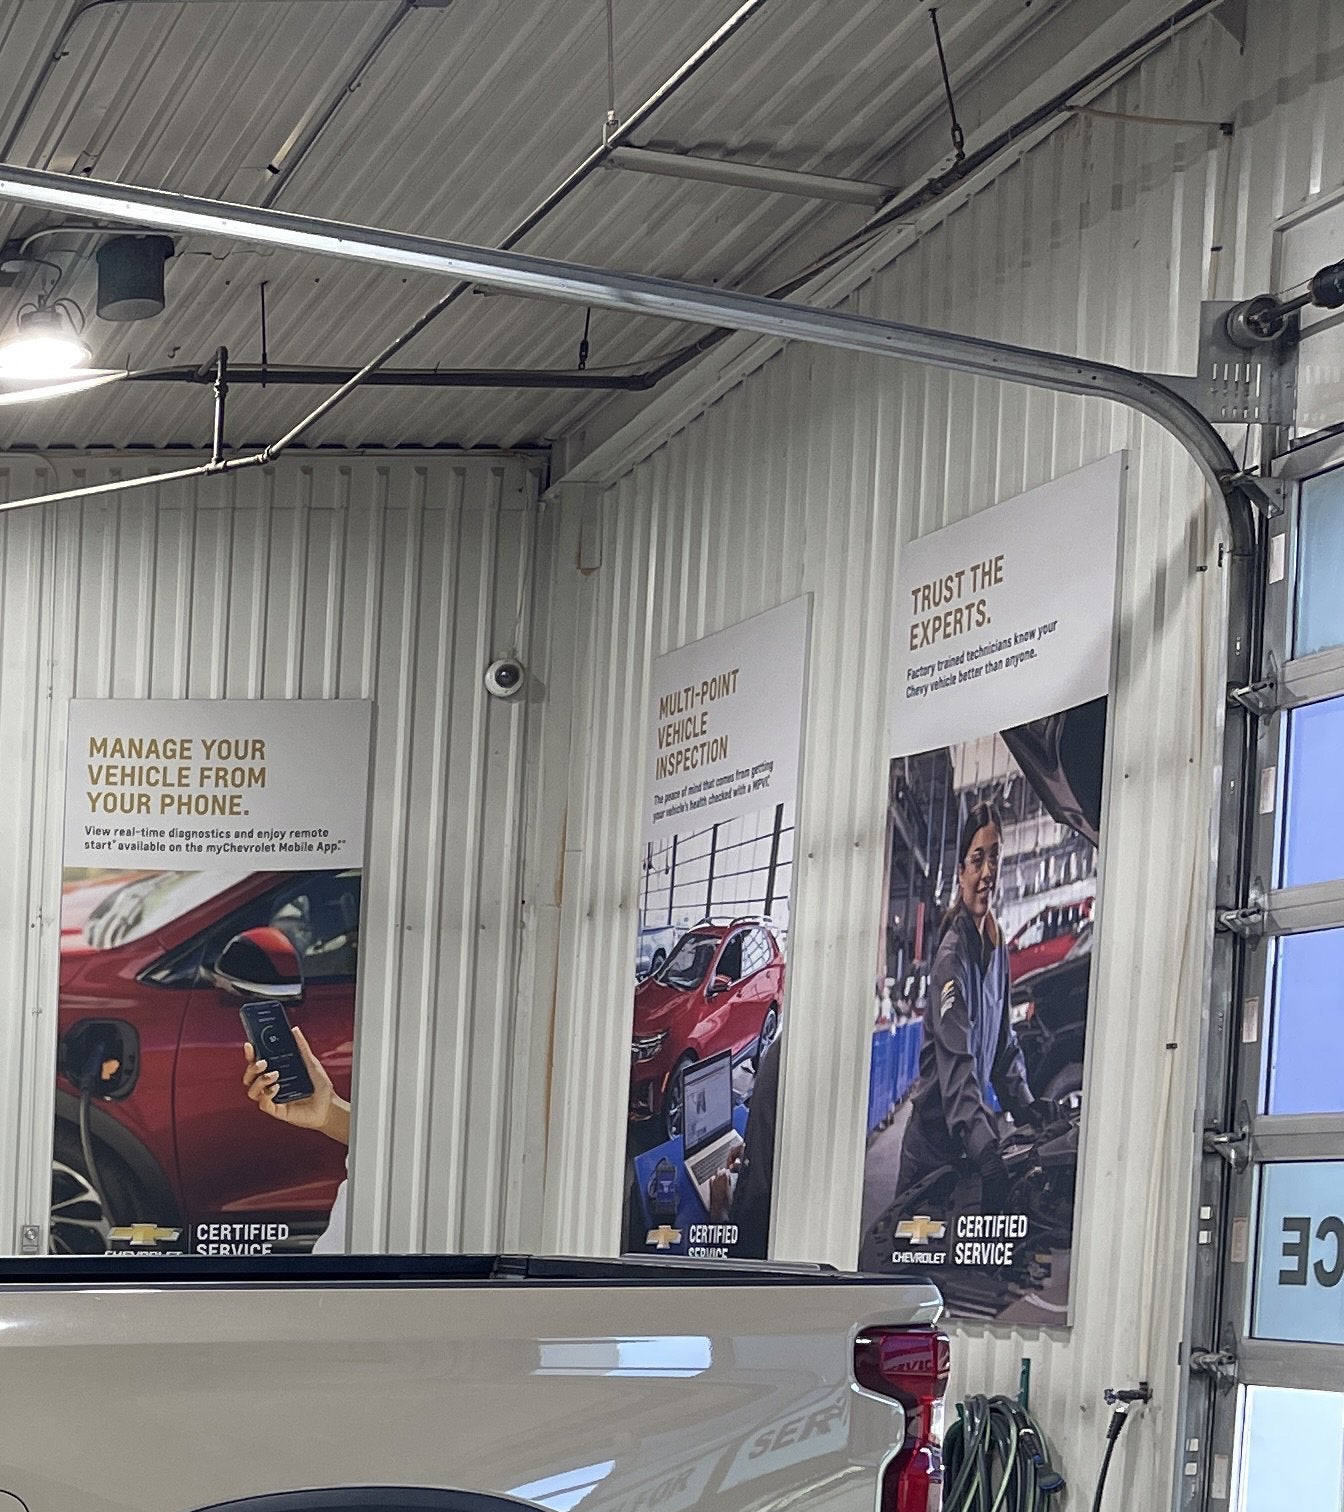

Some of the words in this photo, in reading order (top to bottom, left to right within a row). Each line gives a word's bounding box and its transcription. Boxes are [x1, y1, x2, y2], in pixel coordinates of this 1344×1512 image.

[912, 569, 965, 615] TRUST
[970, 554, 1004, 593] THE
[909, 599, 991, 651] EXPERTS.
[907, 663, 936, 681] Factory
[937, 651, 964, 671] trained
[966, 638, 1012, 661] technicians
[1014, 628, 1036, 646] know
[1038, 620, 1058, 640] your
[906, 682, 929, 698] Chevy
[930, 672, 956, 691] vehicle
[958, 665, 983, 684] better
[985, 659, 1003, 674] than
[1005, 648, 1037, 667] anyone.
[659, 668, 739, 720] MULTI-POINT
[658, 711, 708, 749] VEHICLE
[89, 737, 193, 760] MANAGE
[201, 739, 265, 760] YOUR
[656, 735, 728, 780] INSPECTION
[88, 765, 190, 787] VEHICLE
[200, 767, 266, 788] FROM
[87, 792, 151, 814] YOUR
[160, 794, 250, 815] PHONE.
[85, 826, 110, 836] View
[114, 827, 165, 838] real-time
[169, 828, 231, 840] diagnostics
[234, 829, 253, 838] and
[257, 829, 286, 840] enjoy
[289, 829, 328, 837] remote
[118, 841, 166, 851] available
[169, 843, 182, 851] on
[185, 842, 202, 852] the
[206, 842, 276, 854] myChevrolet
[279, 842, 313, 852] Mobile
[196, 1224, 289, 1240] CERTIFIED
[689, 1225, 738, 1243] CERTIFIED
[957, 1215, 1028, 1238] CERTIFIED
[892, 1252, 946, 1264] CHEVROLET
[954, 1242, 1013, 1265] SERVICE
